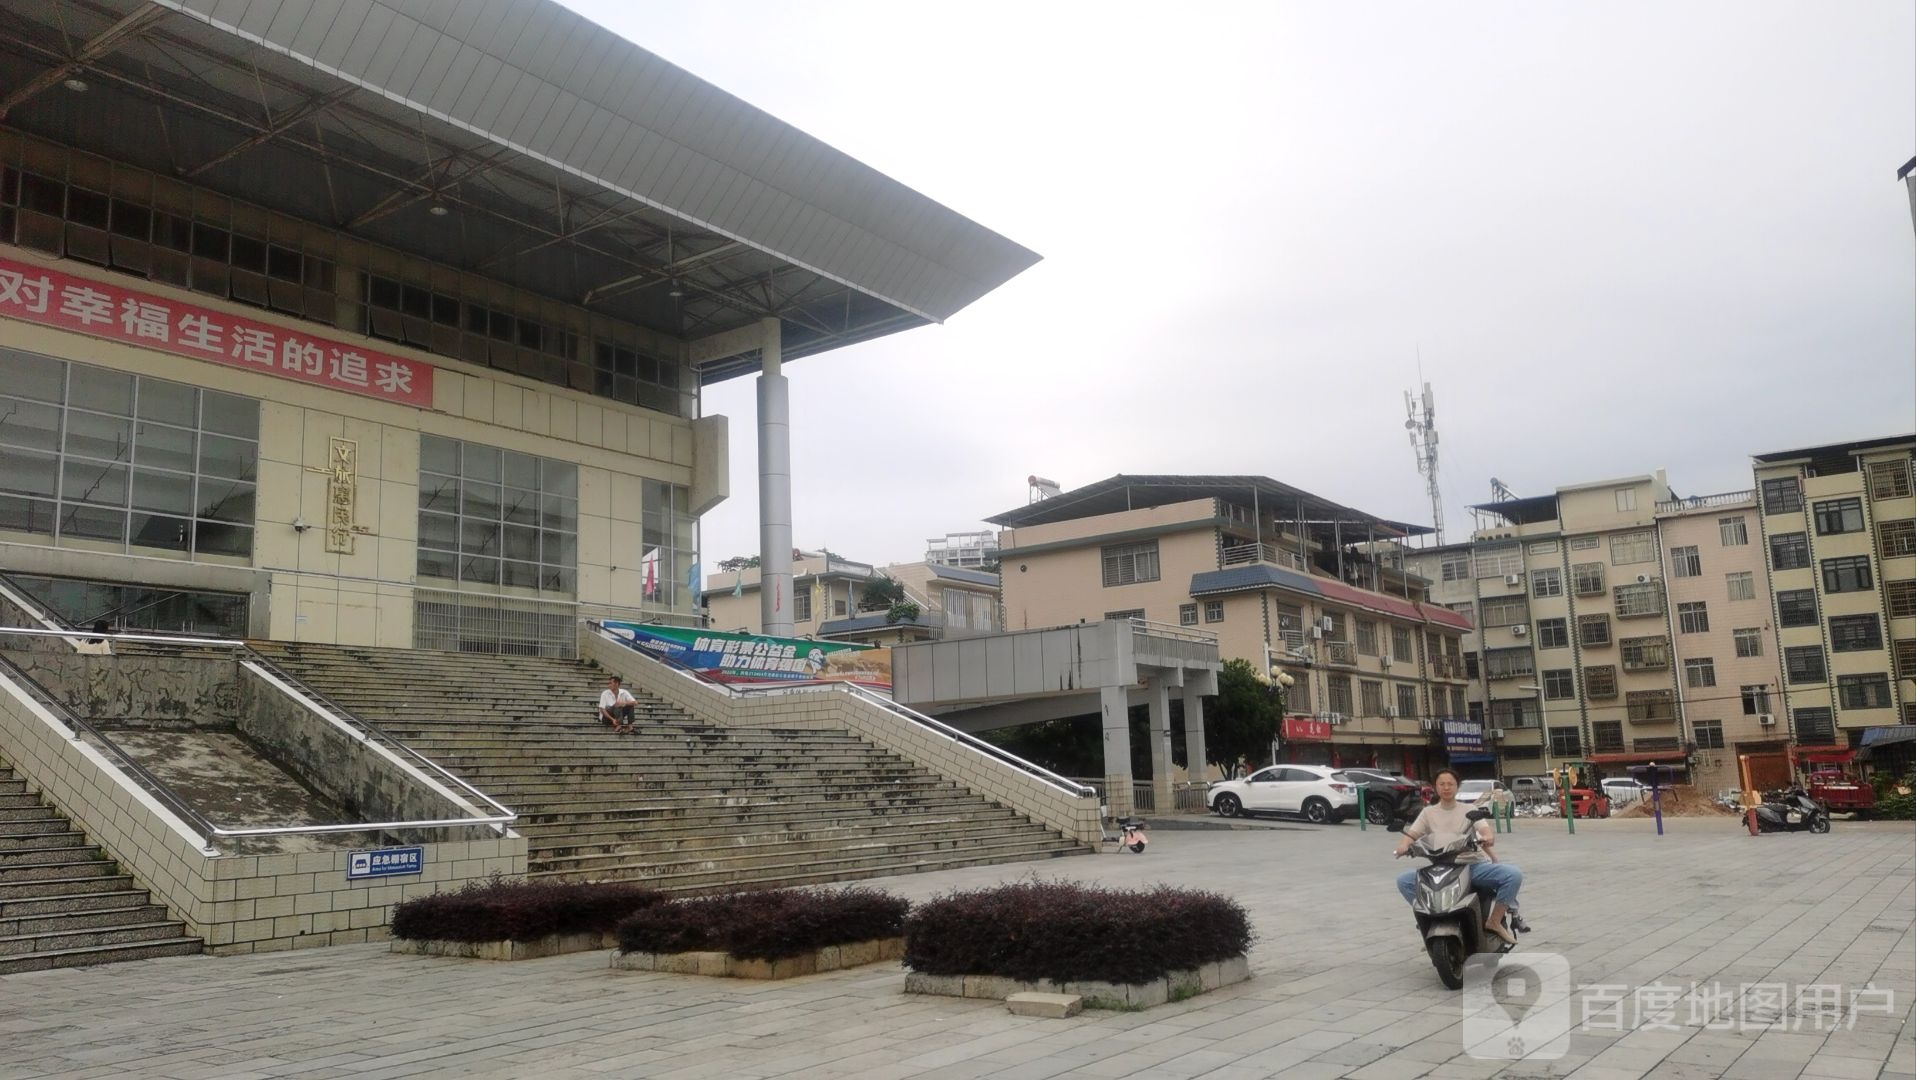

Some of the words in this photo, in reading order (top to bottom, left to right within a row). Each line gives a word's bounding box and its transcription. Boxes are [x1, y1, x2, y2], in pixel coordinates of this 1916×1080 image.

[0, 269, 413, 395] 对幸福生活的追求
[693, 637, 797, 658] 体育彩票公益金
